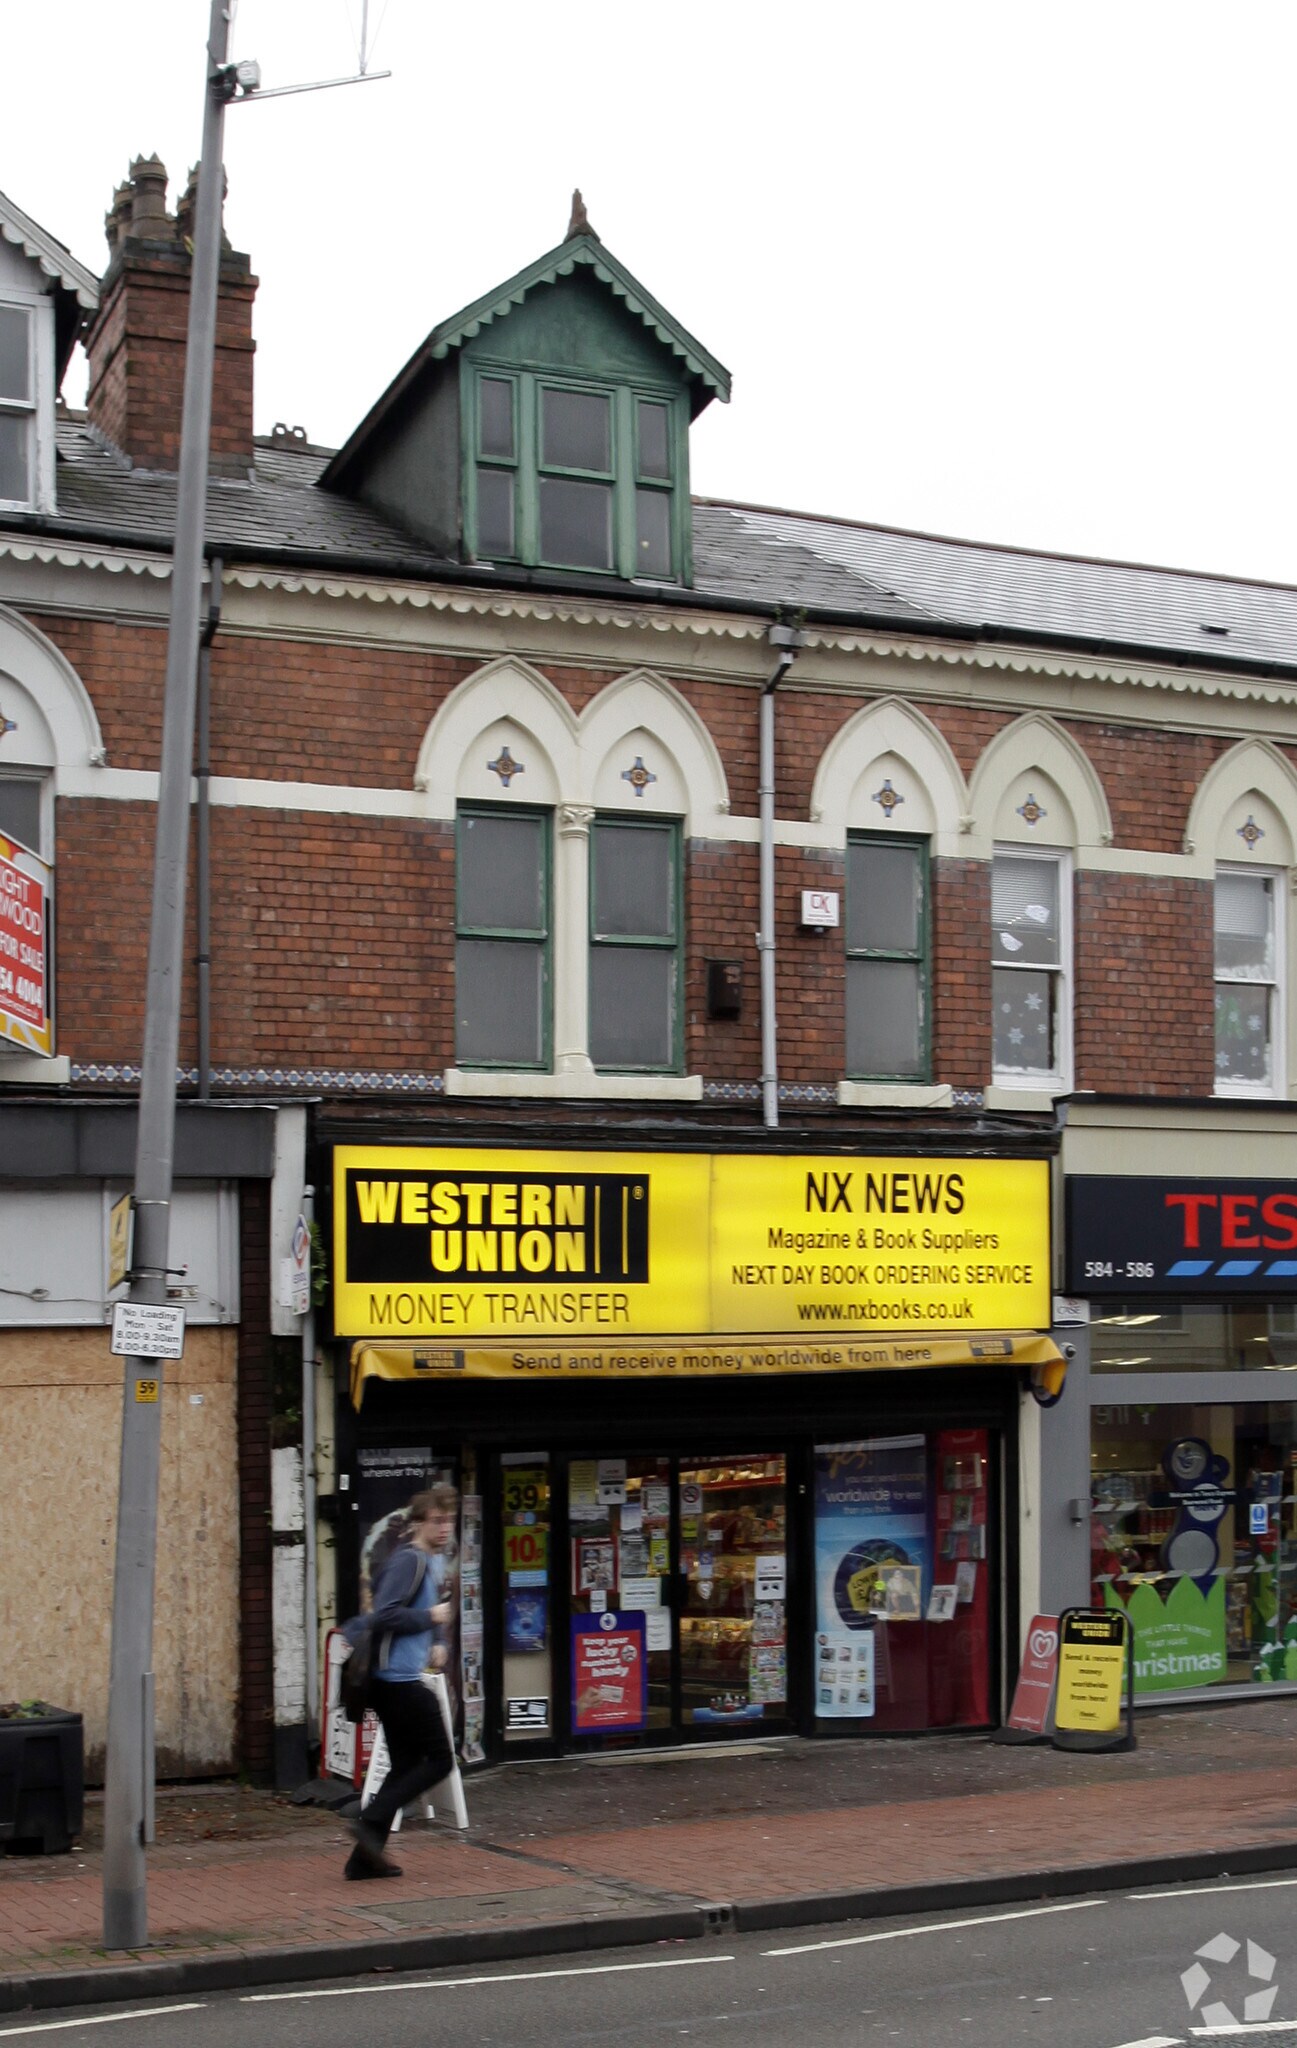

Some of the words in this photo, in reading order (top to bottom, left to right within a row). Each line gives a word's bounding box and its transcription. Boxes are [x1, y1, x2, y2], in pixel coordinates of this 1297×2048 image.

[19, 942, 44, 973] SALE
[355, 1181, 586, 1226] WESTERN
[805, 1172, 853, 1213] NX
[865, 1173, 965, 1215] NEWS
[430, 1230, 586, 1273] UNION
[767, 1227, 851, 1253] Magazine
[855, 1228, 868, 1249] &
[873, 1228, 917, 1249] Book
[922, 1228, 999, 1253] Suppliers
[732, 1265, 777, 1284] NEXT
[782, 1265, 816, 1284] DAY
[821, 1265, 869, 1284] BOOK
[874, 1265, 960, 1284] ORDERING
[964, 1265, 1033, 1284] SERVICE
[1084, 1261, 1113, 1277] 584
[1125, 1262, 1155, 1278] 586
[123, 1308, 137, 1317] No
[141, 1310, 177, 1321] Loading
[369, 1293, 474, 1325] MONEY
[484, 1293, 630, 1324] TRANSFER
[797, 1298, 974, 1320] www.nxbooks.co.uk
[124, 1320, 146, 1329] Mon
[157, 1322, 174, 1332] Sat
[512, 1353, 562, 1370] Send
[568, 1353, 603, 1369] and
[609, 1353, 676, 1369] receive
[682, 1351, 743, 1370] money
[750, 1349, 842, 1367] worldwide
[847, 1347, 889, 1363] from
[893, 1346, 932, 1361] here
[139, 1381, 156, 1393] 59
[825, 1488, 891, 1503] worldwide
